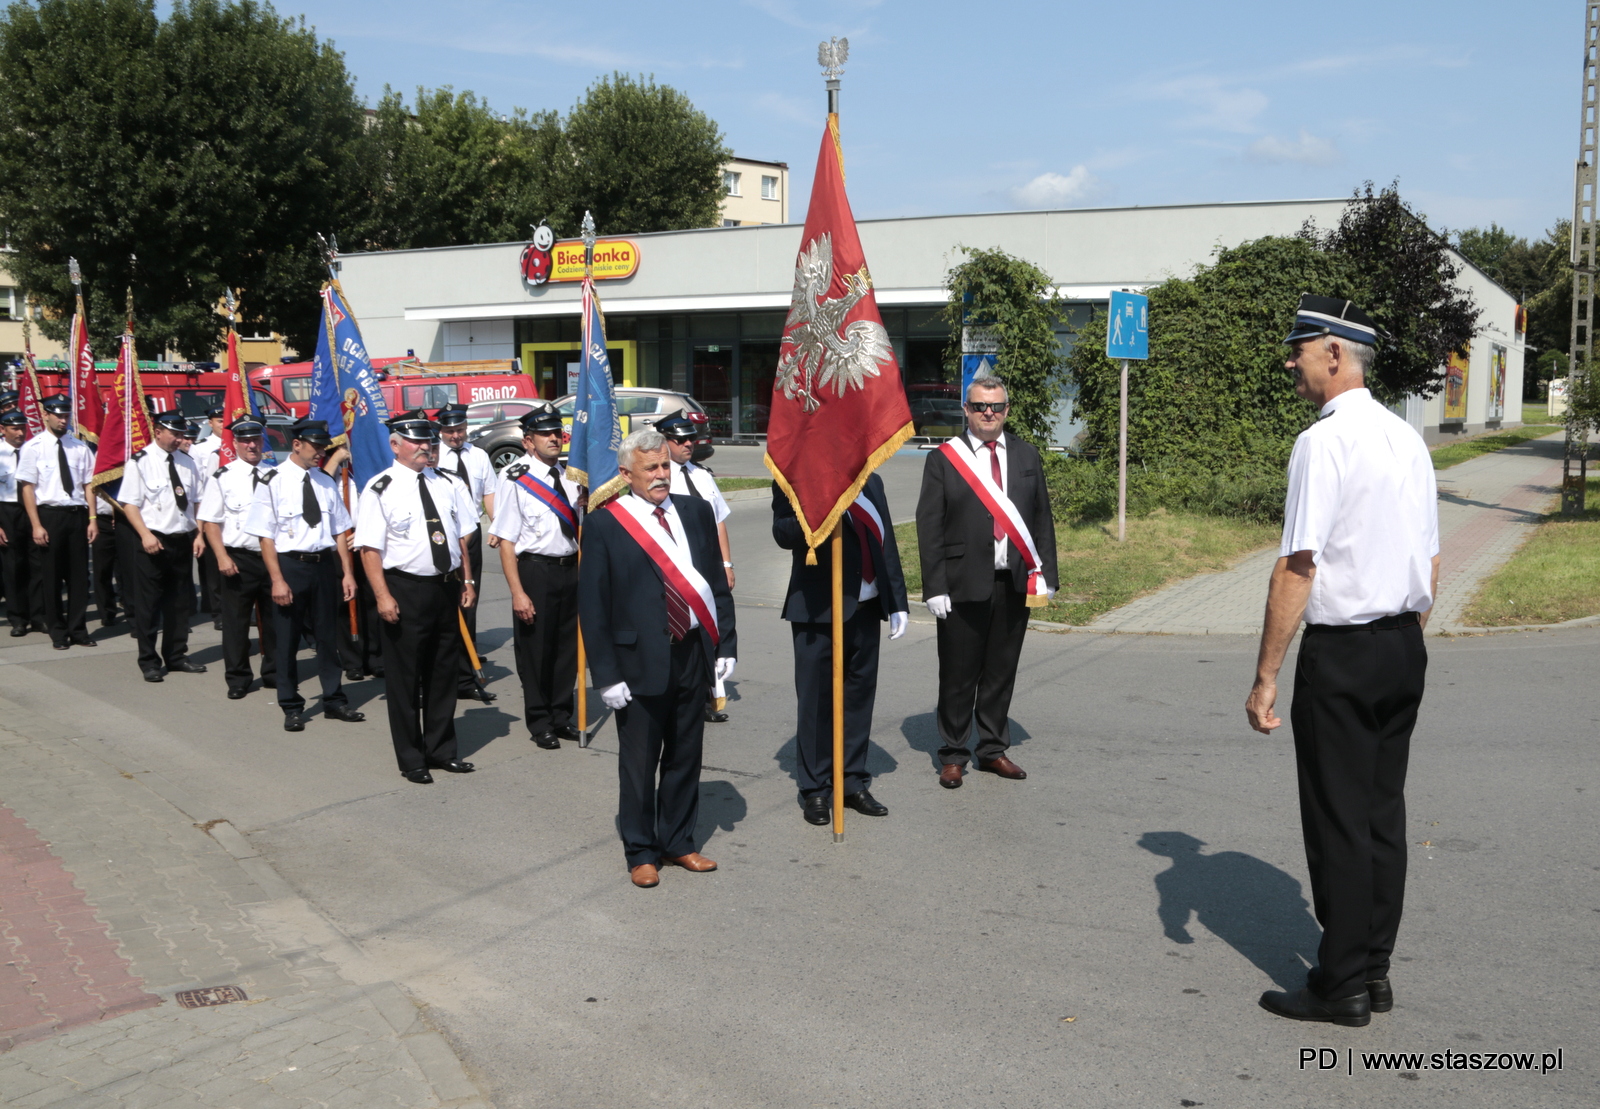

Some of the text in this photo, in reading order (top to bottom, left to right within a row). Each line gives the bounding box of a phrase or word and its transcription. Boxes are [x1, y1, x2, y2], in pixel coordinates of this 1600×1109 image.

[557, 248, 630, 265] Biedonka
[557, 263, 630, 274] Codzienn niskie ceny
[576, 408, 588, 424] 19
